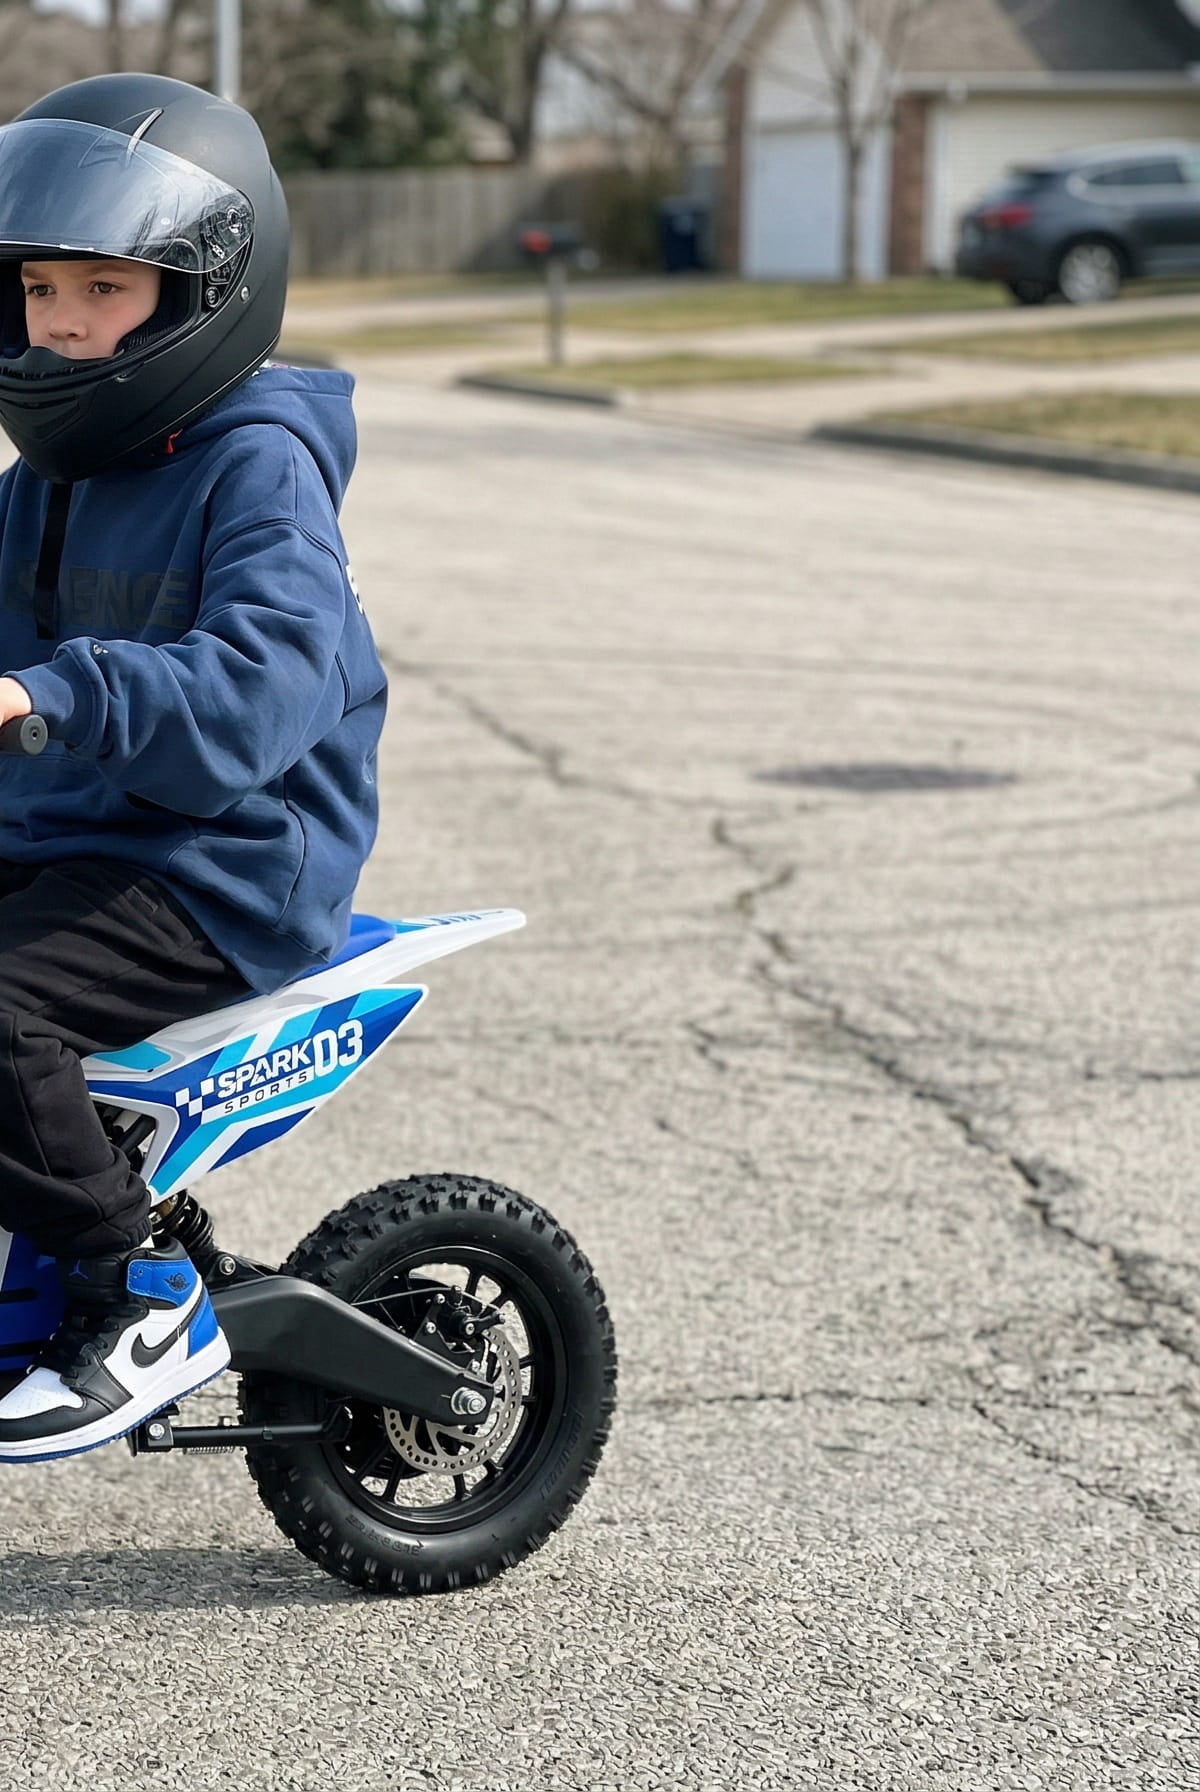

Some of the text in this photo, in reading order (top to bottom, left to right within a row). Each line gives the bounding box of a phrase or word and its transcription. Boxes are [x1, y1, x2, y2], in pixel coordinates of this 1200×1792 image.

[217, 1018, 364, 1099] SPARK 03
[224, 1071, 308, 1114] SPORTS
